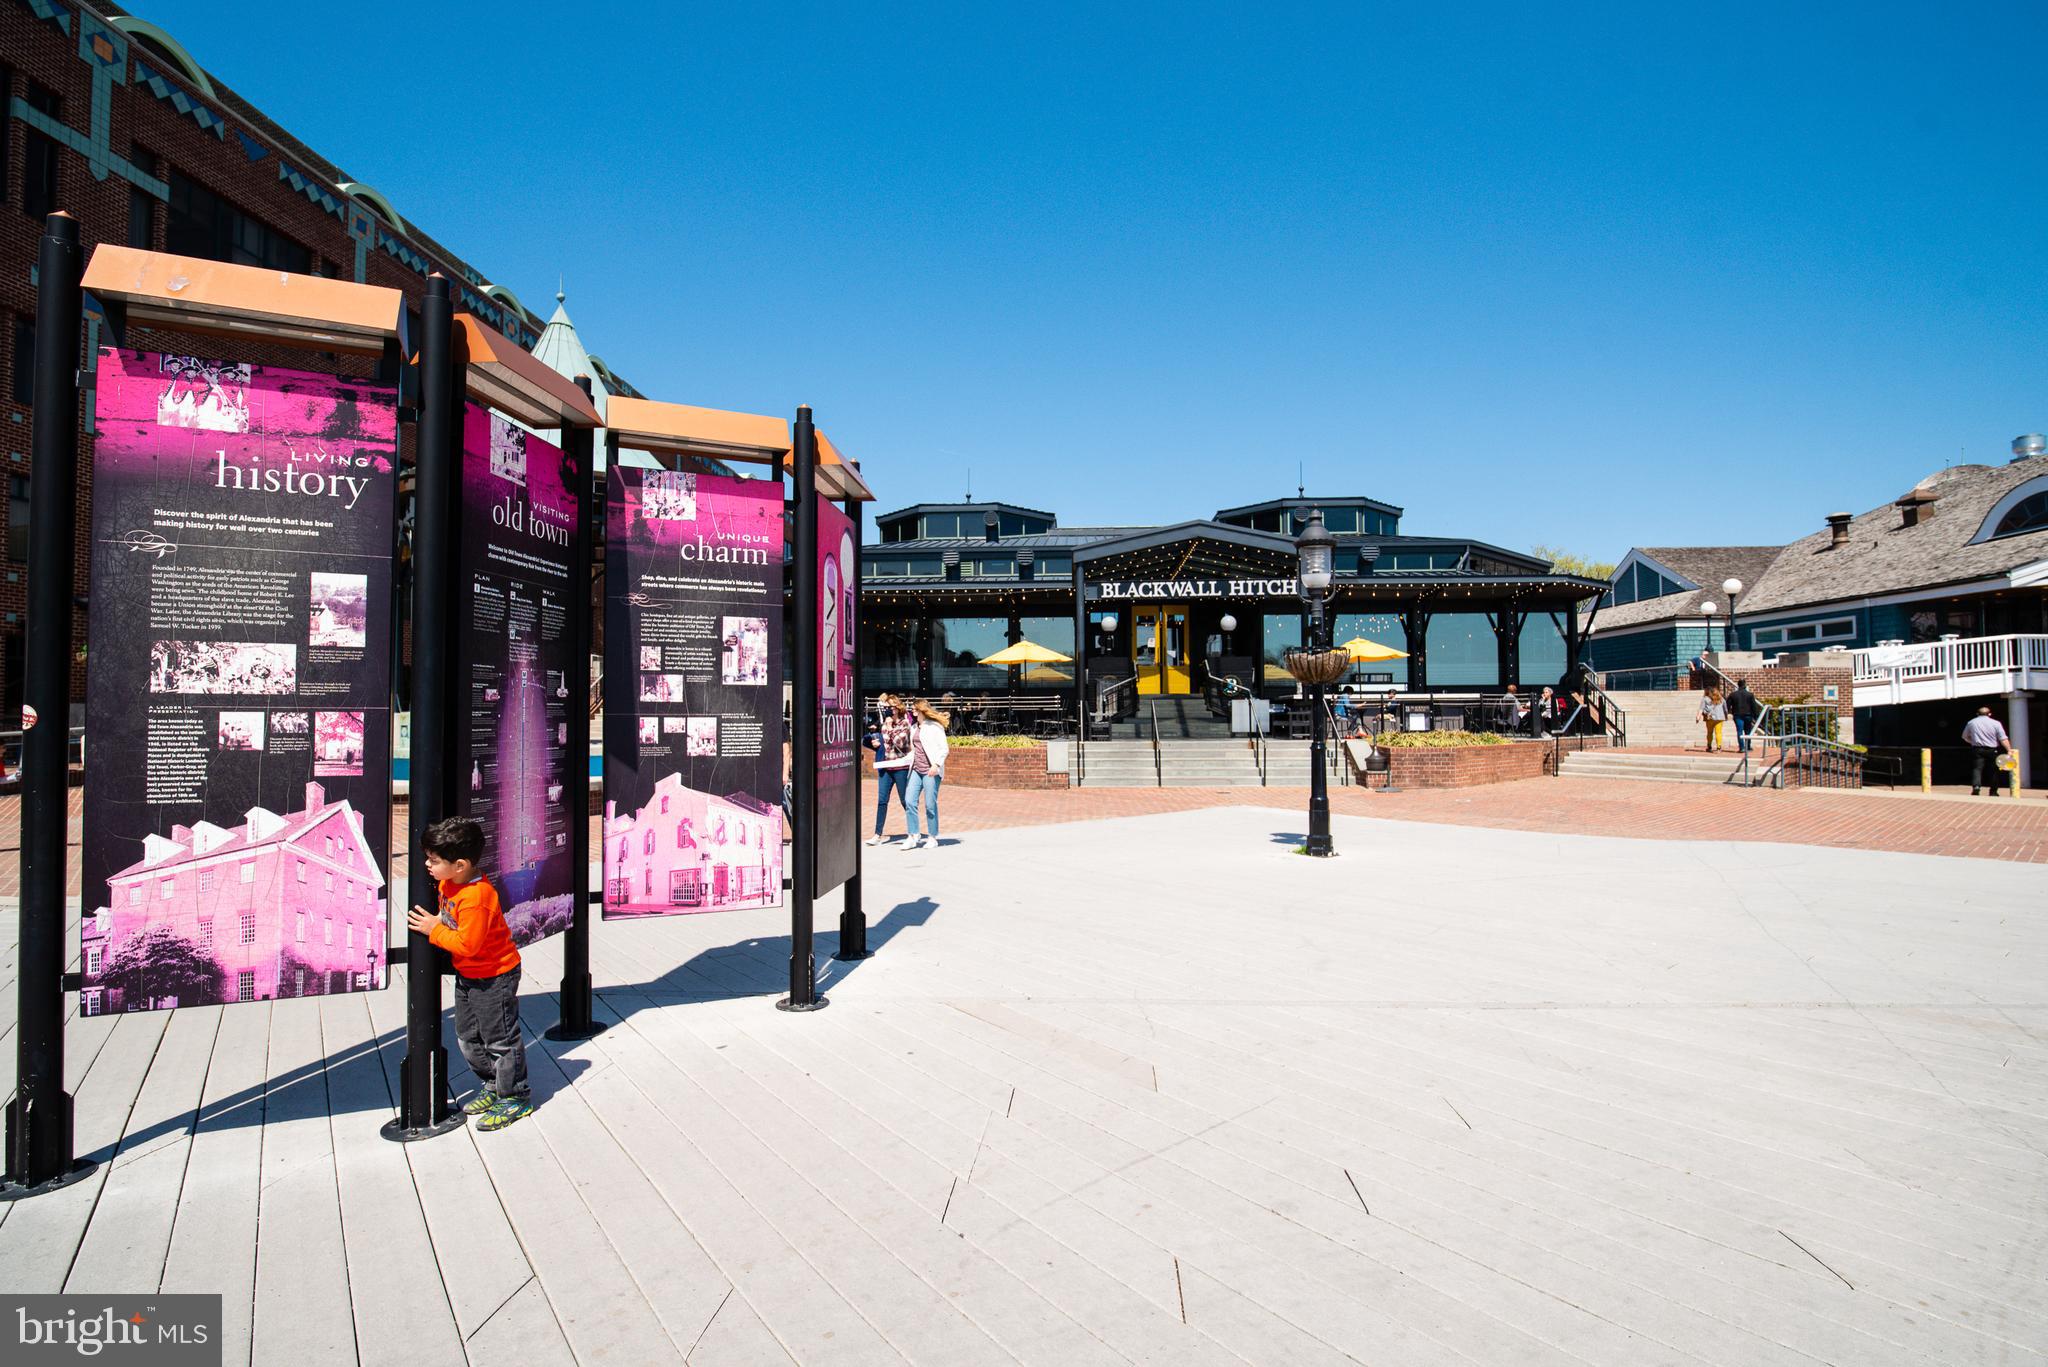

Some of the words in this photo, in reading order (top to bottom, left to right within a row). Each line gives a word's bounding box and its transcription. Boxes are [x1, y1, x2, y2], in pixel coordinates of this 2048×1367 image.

[291, 451, 368, 467] LIVING
[214, 450, 369, 510] history
[154, 509, 189, 518] Discover
[206, 513, 227, 521] spirit
[239, 514, 280, 524] Alexandria
[533, 501, 570, 522] VISITING
[154, 520, 184, 529] making
[186, 521, 214, 531] history
[285, 528, 319, 536] centuries
[493, 496, 523, 532] old
[529, 511, 568, 547] town
[717, 533, 769, 543] UNIQUE
[681, 535, 768, 565] charm
[474, 574, 490, 582] PLAN
[1101, 581, 1221, 598] BLACKWALL
[1229, 580, 1297, 596] HITCH
[839, 675, 853, 710] old
[822, 704, 854, 744] town
[822, 750, 853, 760] ALEXANDRIA
